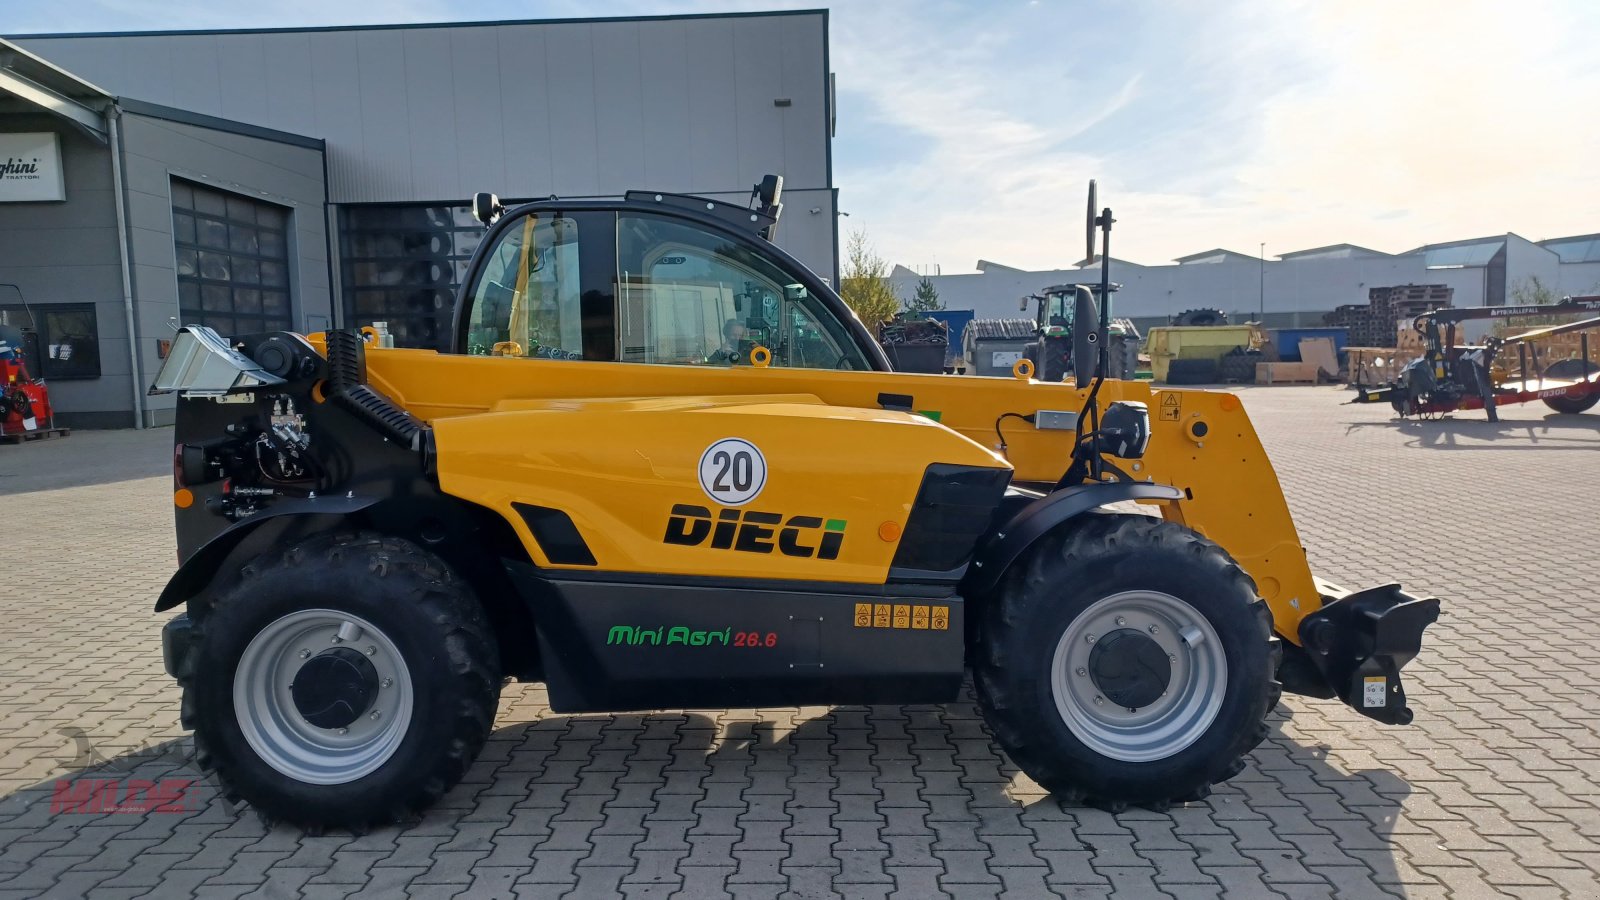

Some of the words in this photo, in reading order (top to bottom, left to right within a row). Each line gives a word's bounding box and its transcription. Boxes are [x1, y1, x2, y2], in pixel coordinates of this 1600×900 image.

[712, 450, 753, 492] 20
[663, 503, 848, 560] DIECI
[607, 625, 663, 646] Mini
[734, 632, 778, 648] 26.6
